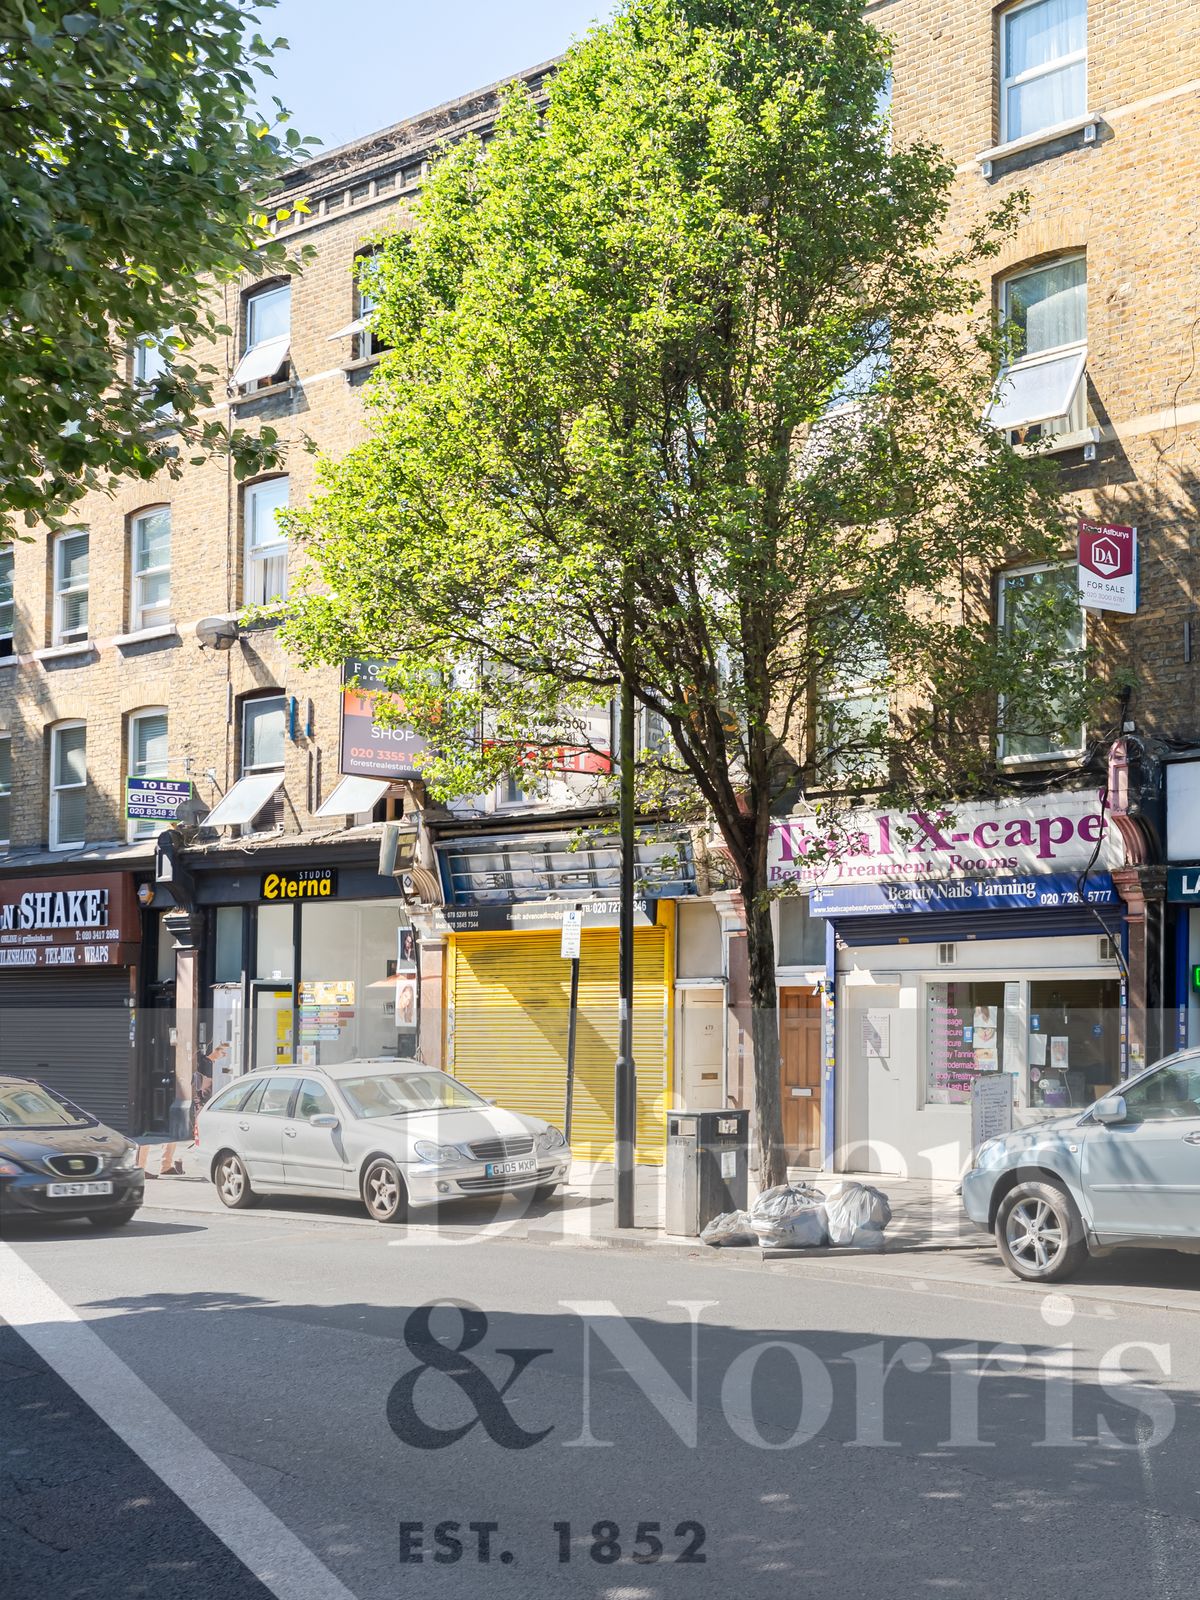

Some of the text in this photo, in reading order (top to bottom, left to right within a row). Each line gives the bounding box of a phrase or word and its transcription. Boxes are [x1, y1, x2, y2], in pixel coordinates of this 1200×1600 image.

[1087, 581, 1125, 594] FOR SALE
[371, 727, 415, 741] SHOP
[351, 747, 374, 758] 020
[377, 750, 405, 761] 3355
[142, 781, 157, 789] TO
[146, 808, 166, 816] 8348
[907, 809, 1108, 859] X-cape
[299, 870, 331, 879] STUDIO
[770, 854, 1018, 883] Beauty Treatment Rooms
[888, 879, 1036, 902] Beauty Nails Tanning
[1040, 893, 1058, 904] 020
[1088, 890, 1111, 902] 5777
[20, 889, 108, 930] SHAKE
[593, 903, 606, 914] 020
[608, 902, 621, 913] 727
[633, 900, 647, 911] 346
[85, 945, 109, 963] WRAPS
